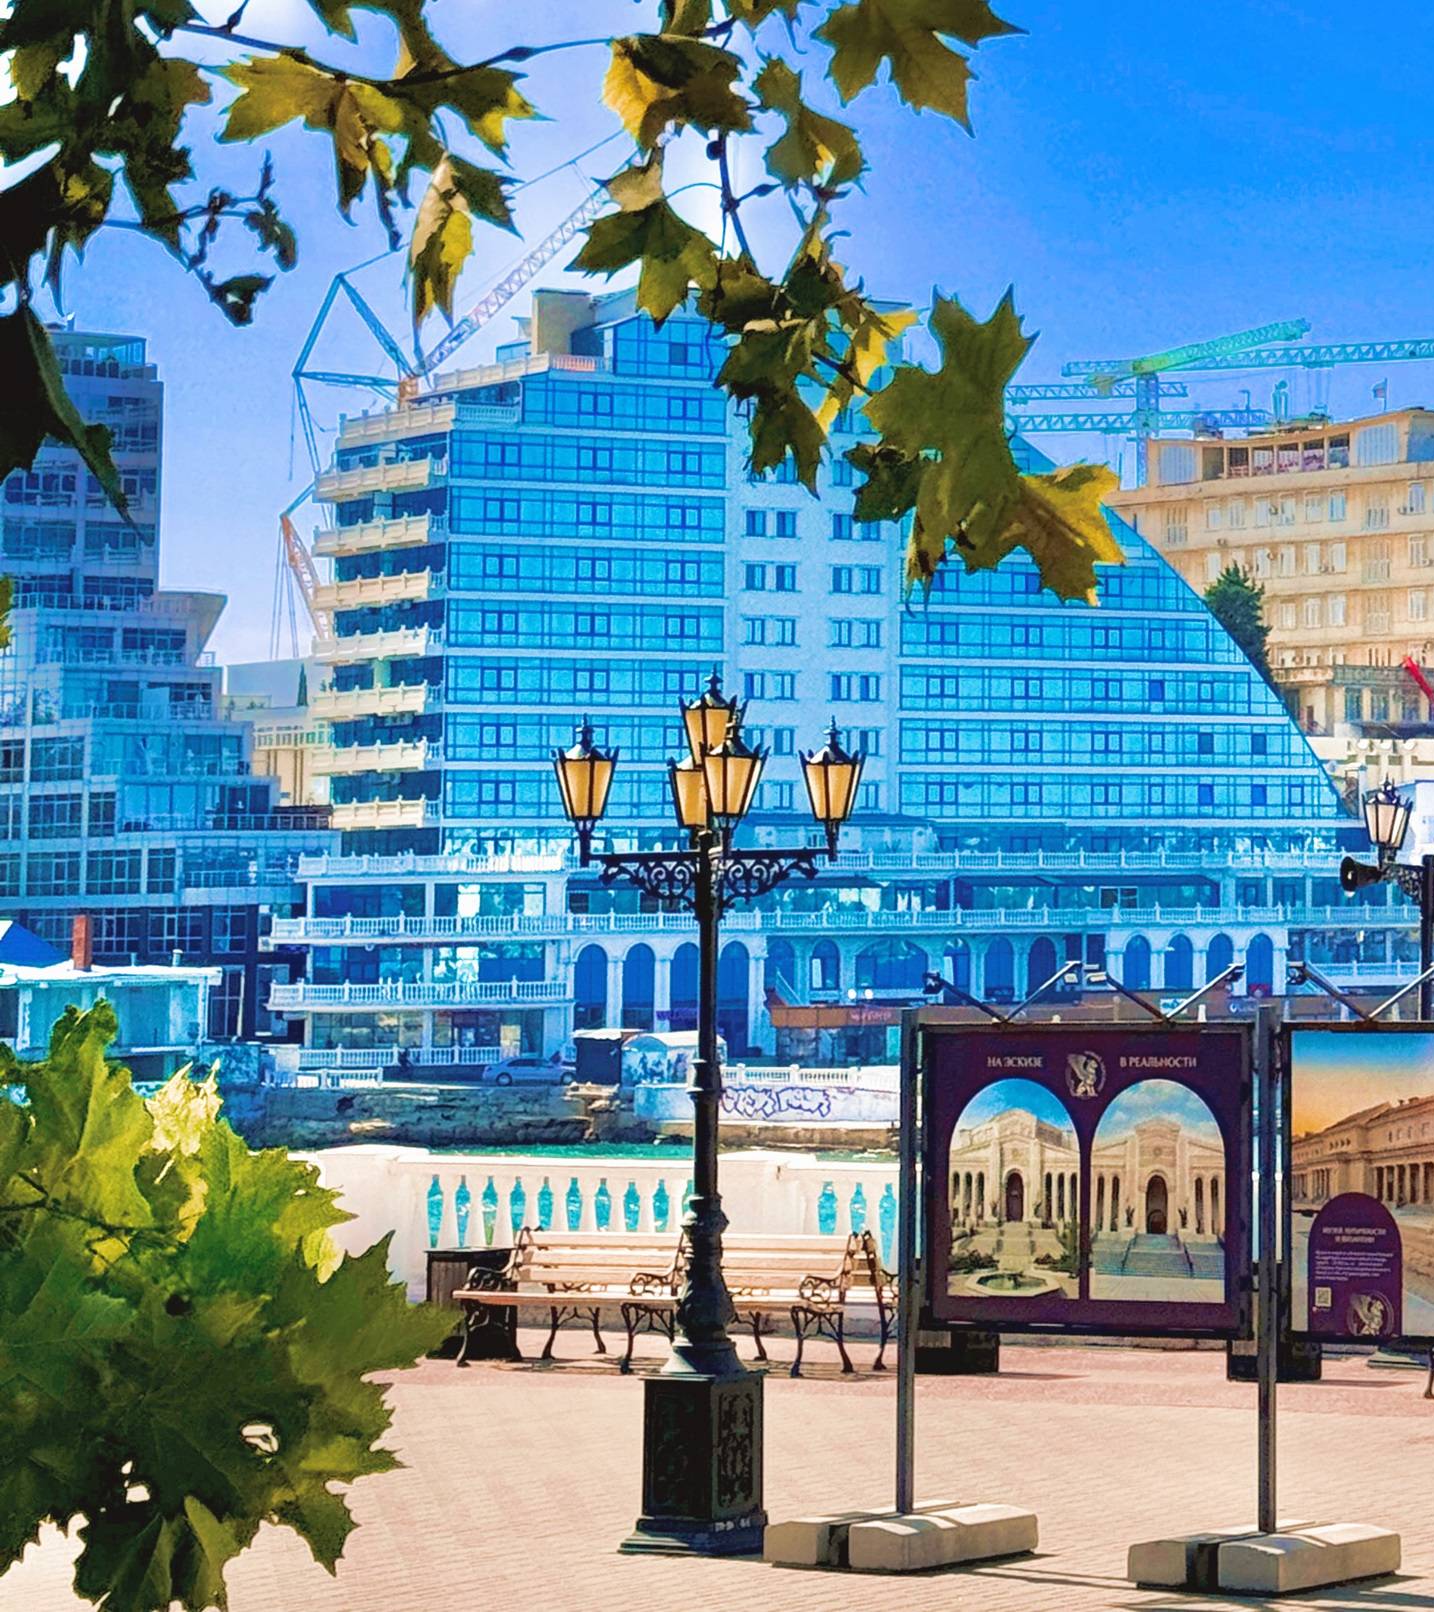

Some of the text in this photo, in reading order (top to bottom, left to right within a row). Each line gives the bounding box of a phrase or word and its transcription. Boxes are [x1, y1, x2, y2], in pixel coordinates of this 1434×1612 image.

[987, 1056, 1042, 1067] НА ЭСКИЗЕ
[1119, 1056, 1197, 1068] В РЕАЛЬНОСТИ
